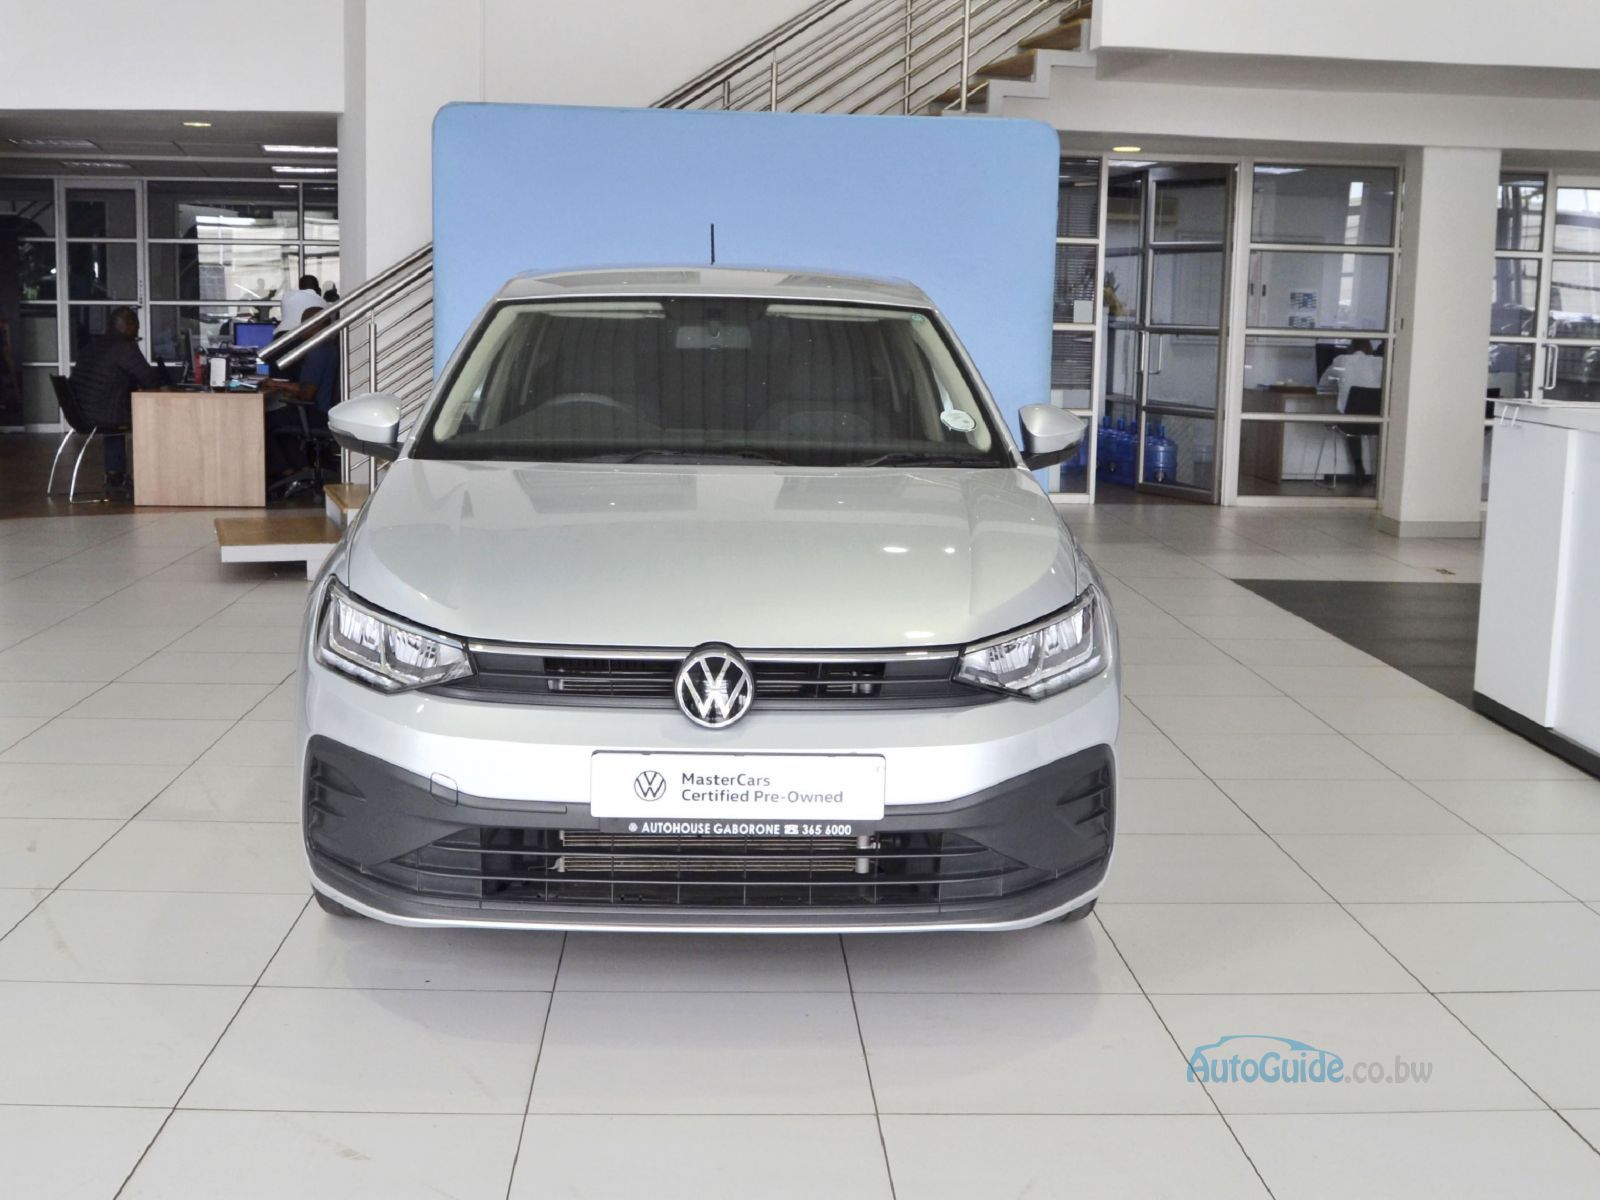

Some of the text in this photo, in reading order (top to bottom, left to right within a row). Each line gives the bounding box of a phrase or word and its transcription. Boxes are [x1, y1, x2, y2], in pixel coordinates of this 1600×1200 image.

[682, 773, 770, 787] MasterCars
[681, 788, 844, 803] Certified Pre-Owned
[641, 822, 711, 835] AUTOHOUSE
[713, 823, 780, 835] GABORONE
[801, 824, 822, 835] 365
[824, 824, 852, 835] 6000
